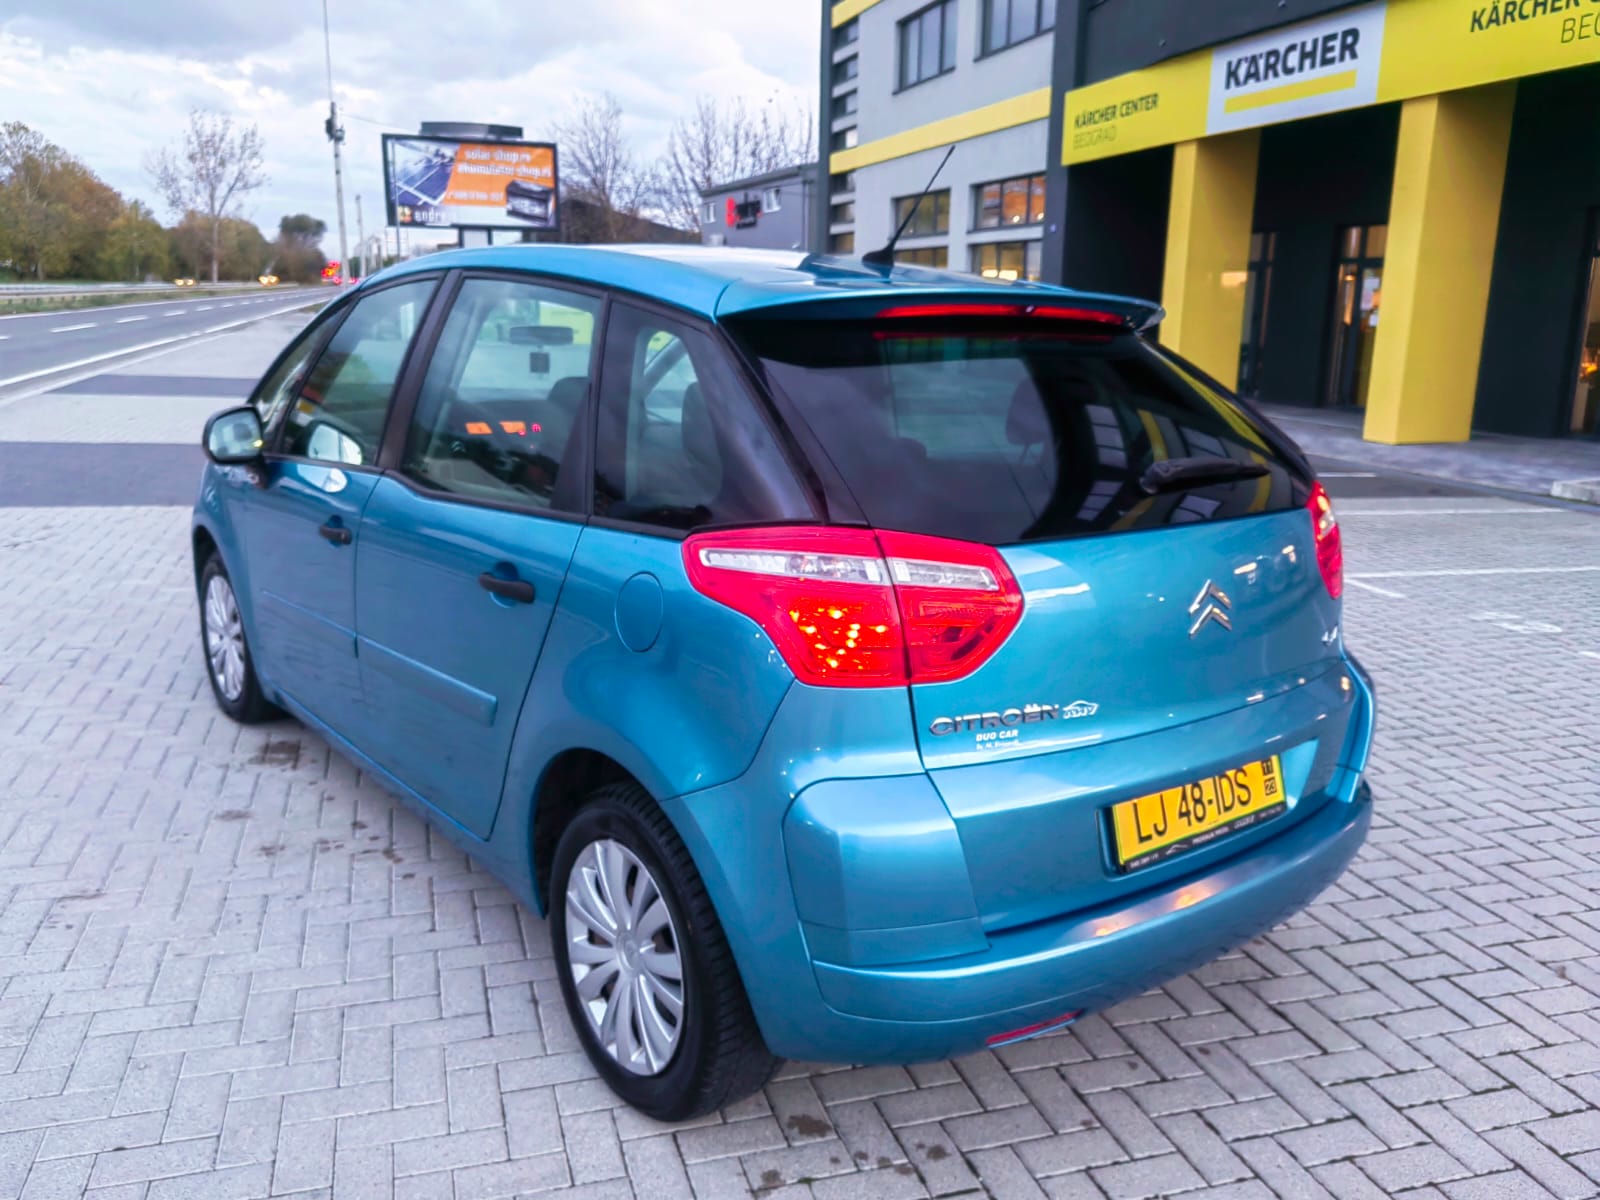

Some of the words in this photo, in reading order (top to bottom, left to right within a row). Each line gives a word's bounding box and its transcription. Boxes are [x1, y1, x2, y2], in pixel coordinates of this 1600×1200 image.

[1223, 27, 1360, 90] KÄRCHER
[1119, 93, 1159, 117] CENTER
[929, 703, 1060, 736] CITROËN
[976, 731, 997, 742] DUO
[999, 729, 1019, 739] CAR
[1132, 792, 1168, 844] LJ
[1178, 768, 1252, 827] 48-IDS
